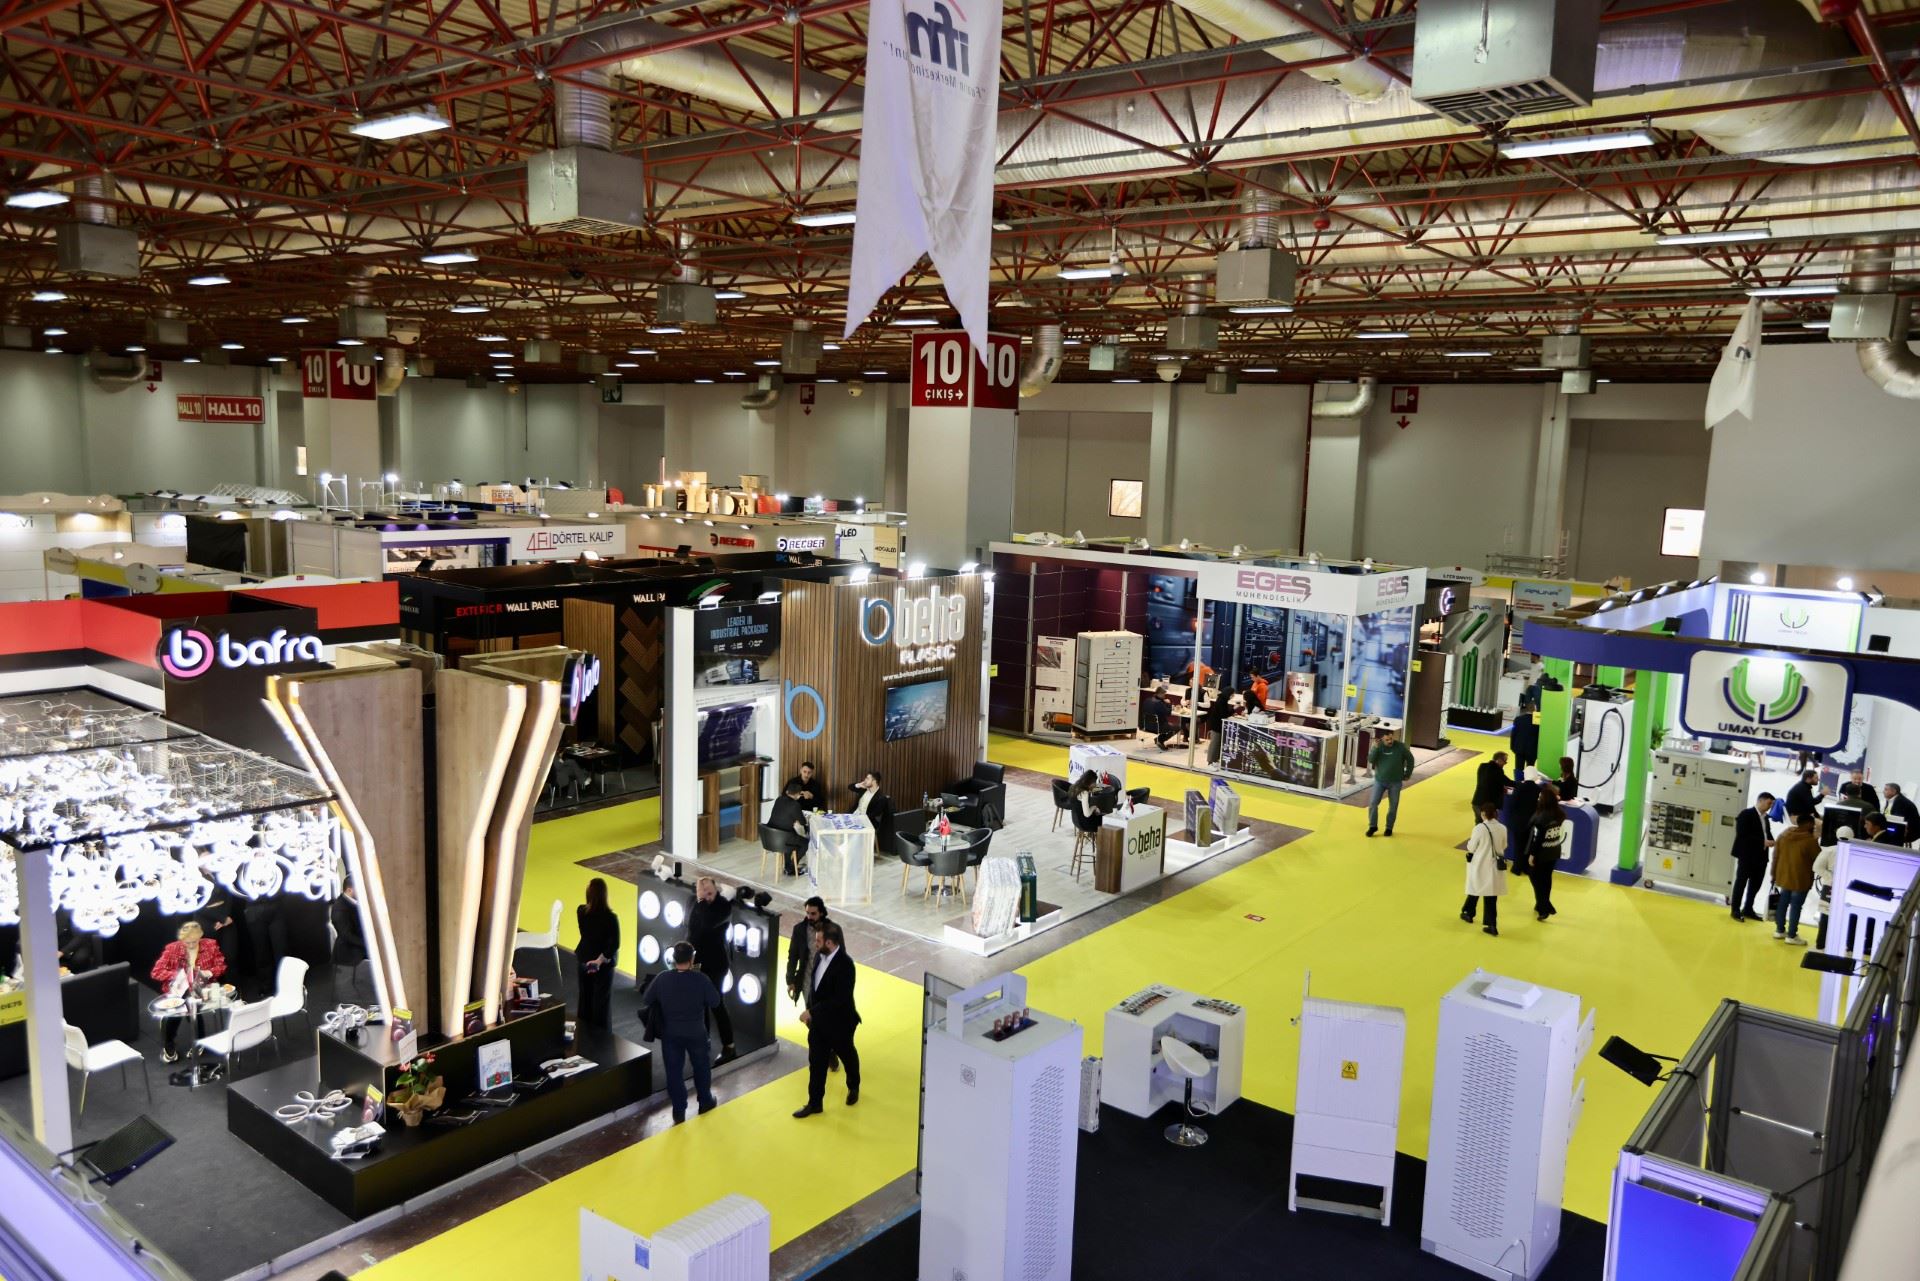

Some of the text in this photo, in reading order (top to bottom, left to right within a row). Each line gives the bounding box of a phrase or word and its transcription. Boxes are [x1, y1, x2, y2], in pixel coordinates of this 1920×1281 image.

[305, 355, 323, 384] 10
[920, 340, 962, 385] 10
[986, 344, 1015, 388] 10
[925, 388, 953, 400] ÇIKIŞ
[178, 402, 201, 414] HALL 10
[208, 402, 260, 417] HALL 10
[552, 531, 588, 545] DÖRTEL
[589, 531, 614, 543] KALIP
[1237, 570, 1311, 602] EGES
[1377, 575, 1409, 598] EGES
[506, 601, 529, 613] WALL
[531, 599, 559, 612] PANEL
[633, 593, 655, 604] WALL
[894, 585, 966, 648] beha
[218, 628, 324, 668] bafra
[1718, 722, 1803, 741] UMAY TECH
[1138, 826, 1161, 854] beha
